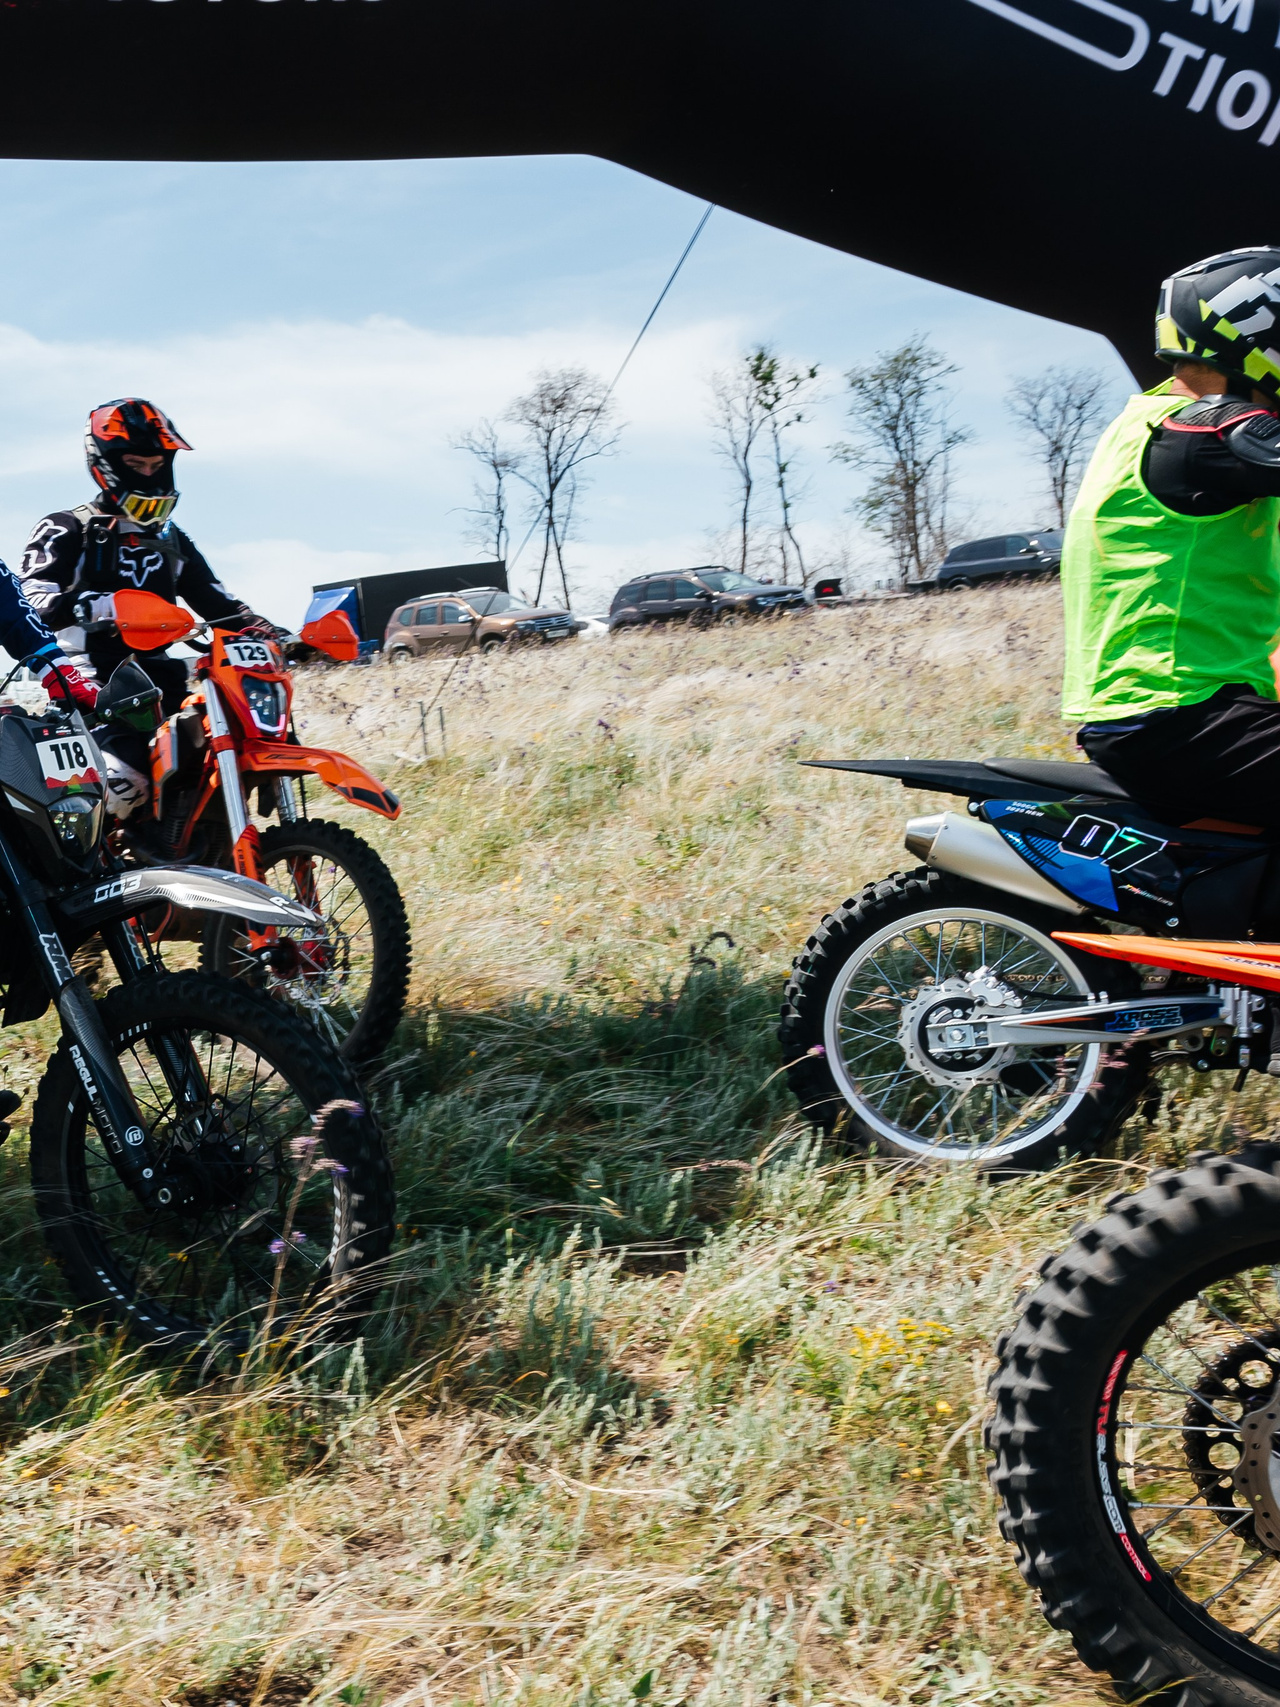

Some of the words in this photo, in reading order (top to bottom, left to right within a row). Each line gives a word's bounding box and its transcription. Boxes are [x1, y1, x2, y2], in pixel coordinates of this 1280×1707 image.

[233, 645, 268, 662] 129
[49, 741, 88, 771] 118
[107, 777, 145, 806] OX
[1058, 813, 1169, 874] 07
